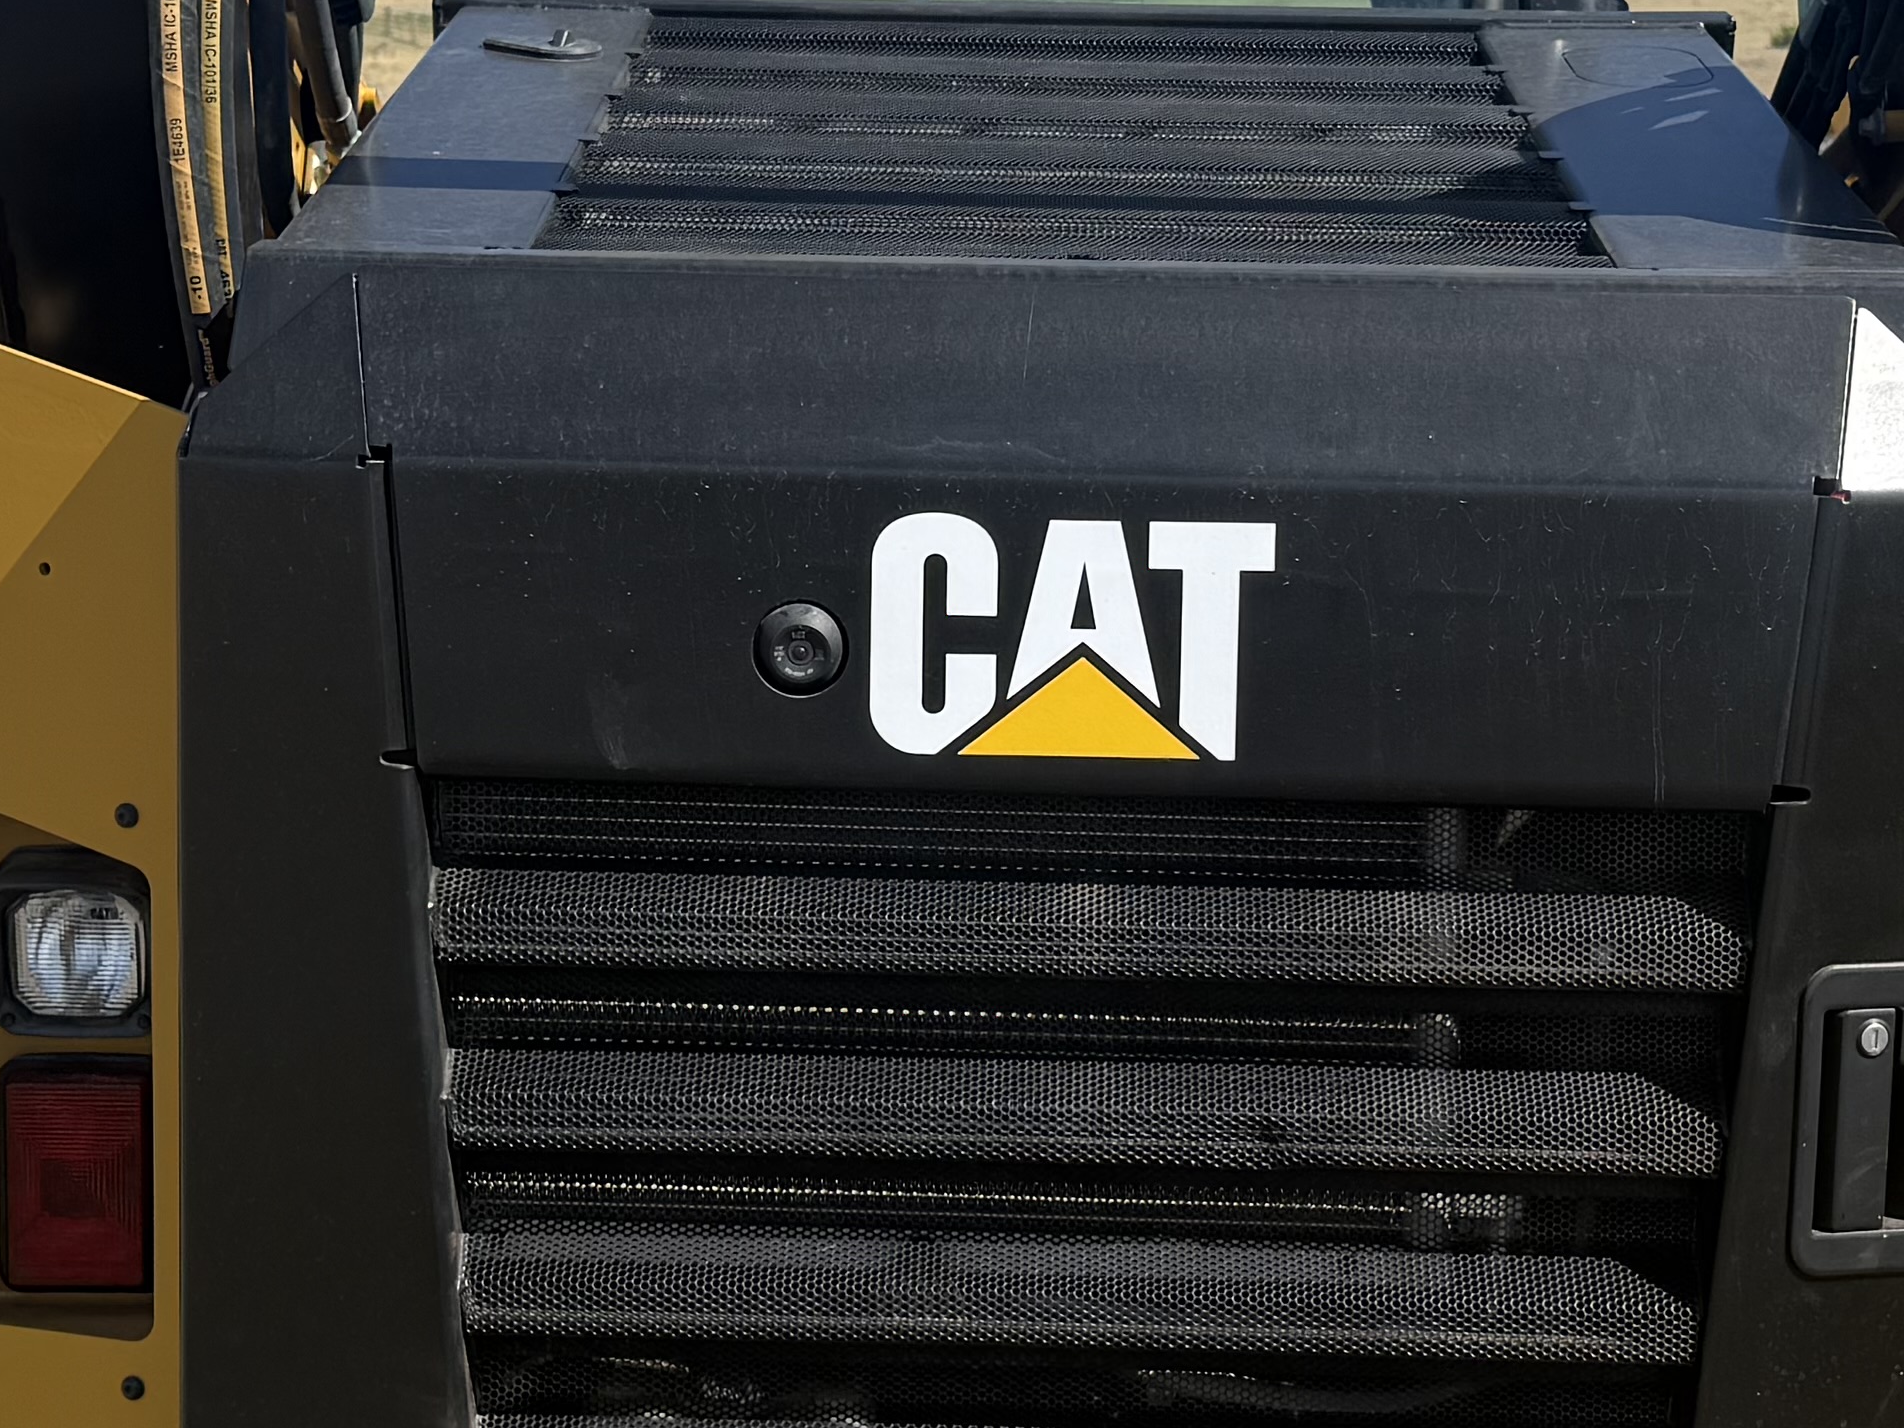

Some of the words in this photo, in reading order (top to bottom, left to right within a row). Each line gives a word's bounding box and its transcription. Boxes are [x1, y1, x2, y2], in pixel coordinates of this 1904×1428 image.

[205, 0, 218, 40] MSHA
[165, 31, 179, 72] MSHA
[204, 44, 217, 104] IC-101/36
[170, 118, 186, 163] 1E4639
[190, 276, 203, 300] -10
[869, 512, 1276, 761] CAT
